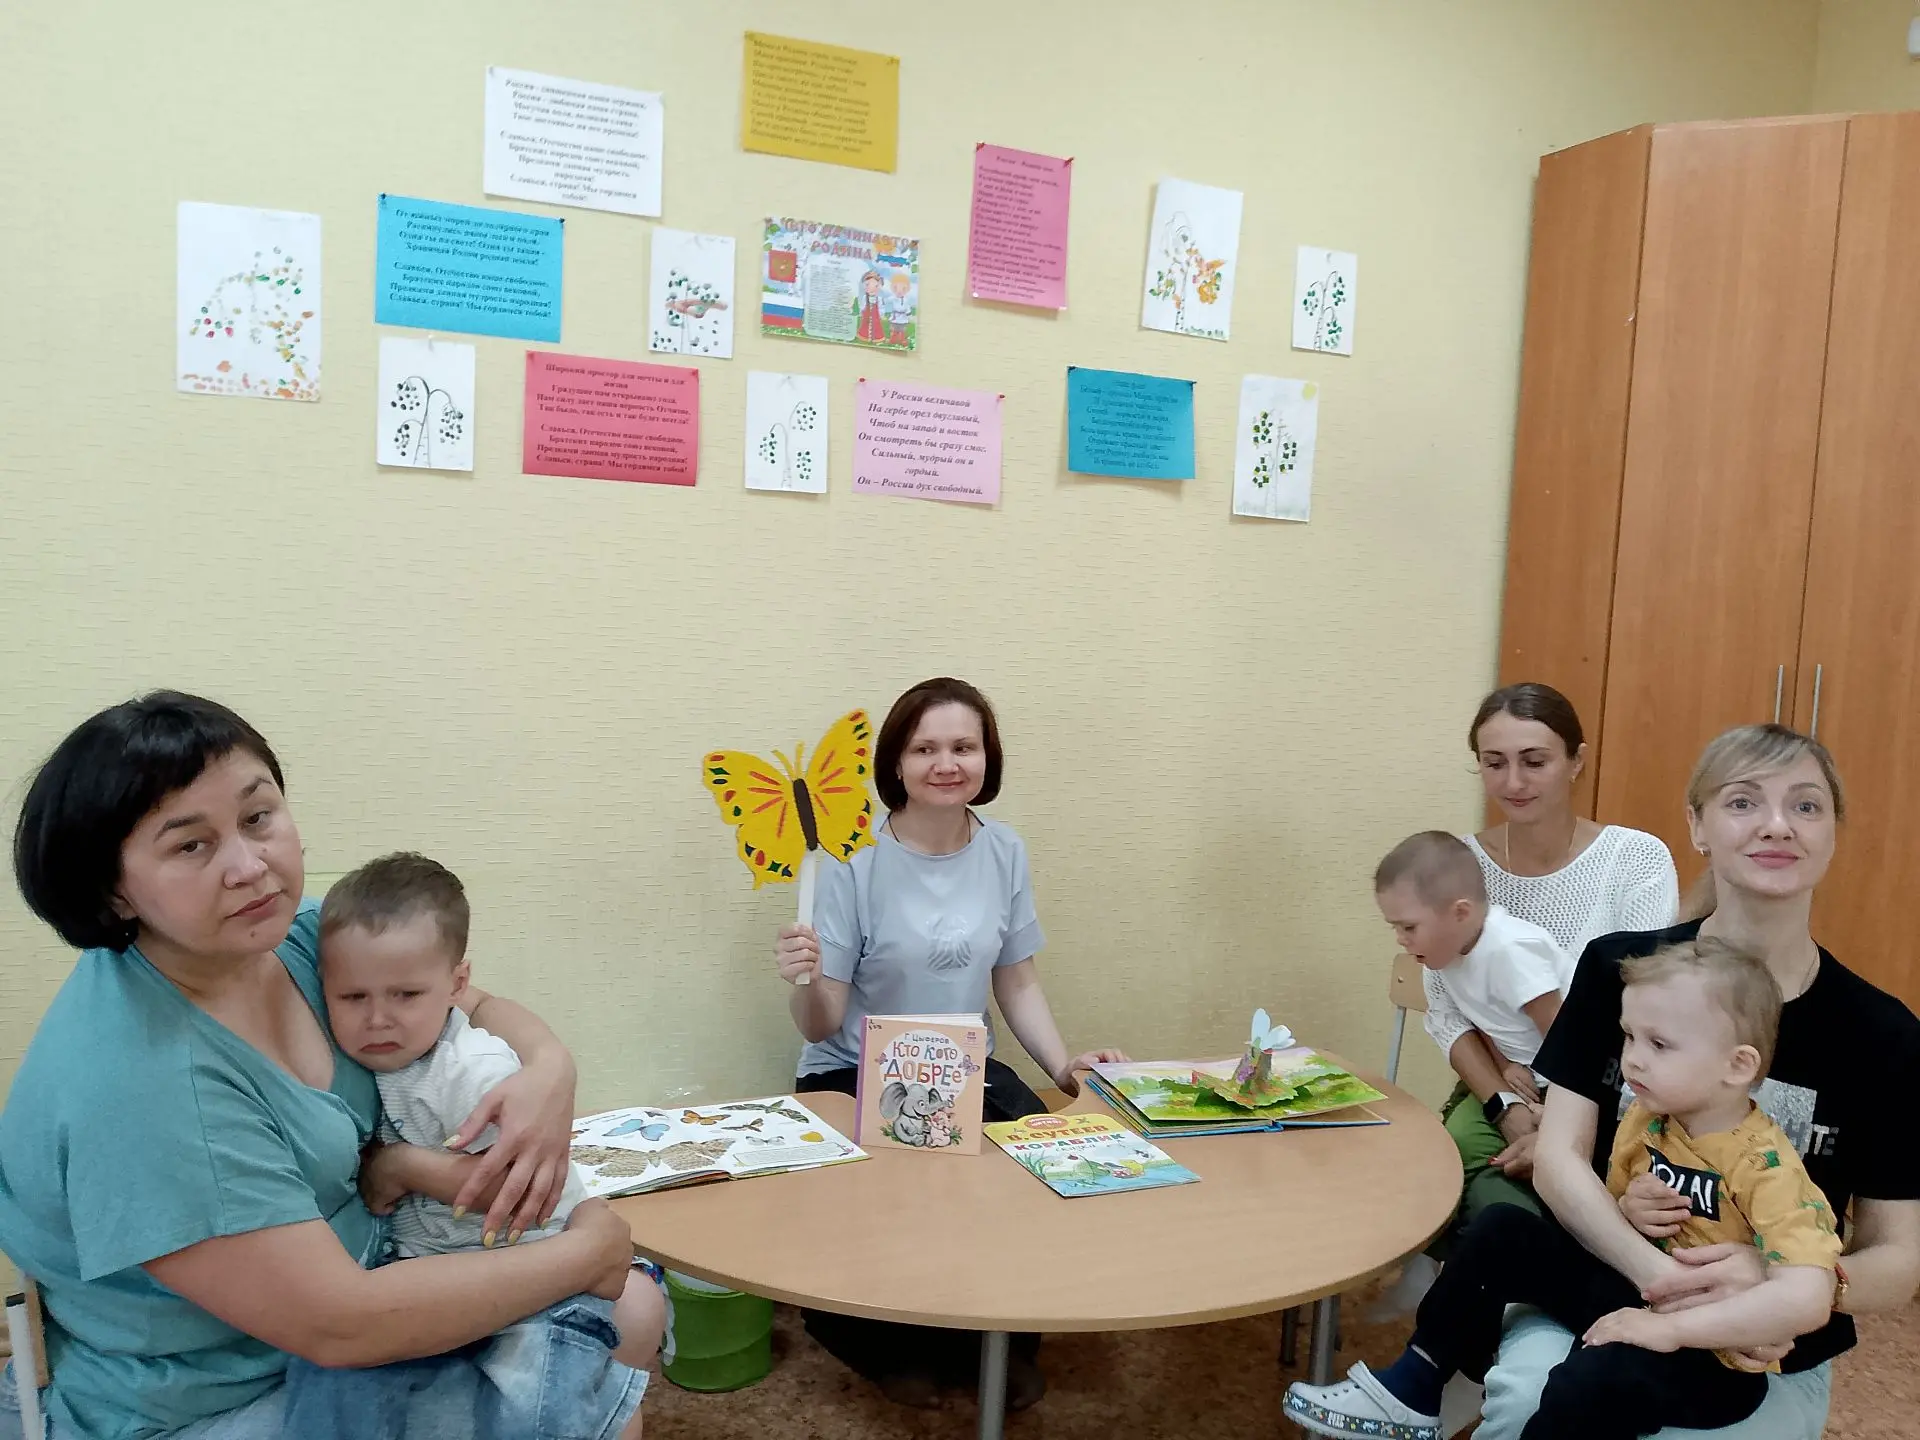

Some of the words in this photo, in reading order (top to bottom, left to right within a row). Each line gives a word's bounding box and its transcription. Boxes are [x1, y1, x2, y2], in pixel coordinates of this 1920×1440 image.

[810, 240, 873, 261] РОДИНА
[880, 389, 890, 398] У
[890, 390, 923, 402] России
[924, 396, 972, 408] величавой
[868, 402, 882, 413] На
[884, 406, 909, 417] гербе
[910, 409, 931, 419] орел
[869, 418, 897, 429] Чтоб
[898, 423, 910, 431] на
[911, 424, 938, 433] запад
[946, 429, 979, 437] восток
[858, 432, 872, 441] Он
[873, 436, 923, 447] смотреть
[924, 438, 938, 448] бы
[939, 442, 964, 452] сразу
[871, 447, 916, 461] Сильный,
[917, 455, 954, 464] мудрый
[904, 467, 940, 477] гордый.
[857, 475, 871, 485] Он
[881, 477, 914, 489] России
[915, 482, 932, 492] дух
[932, 484, 983, 495] свободный.
[1014, 1133, 1126, 1151] КОРАБЛИК
